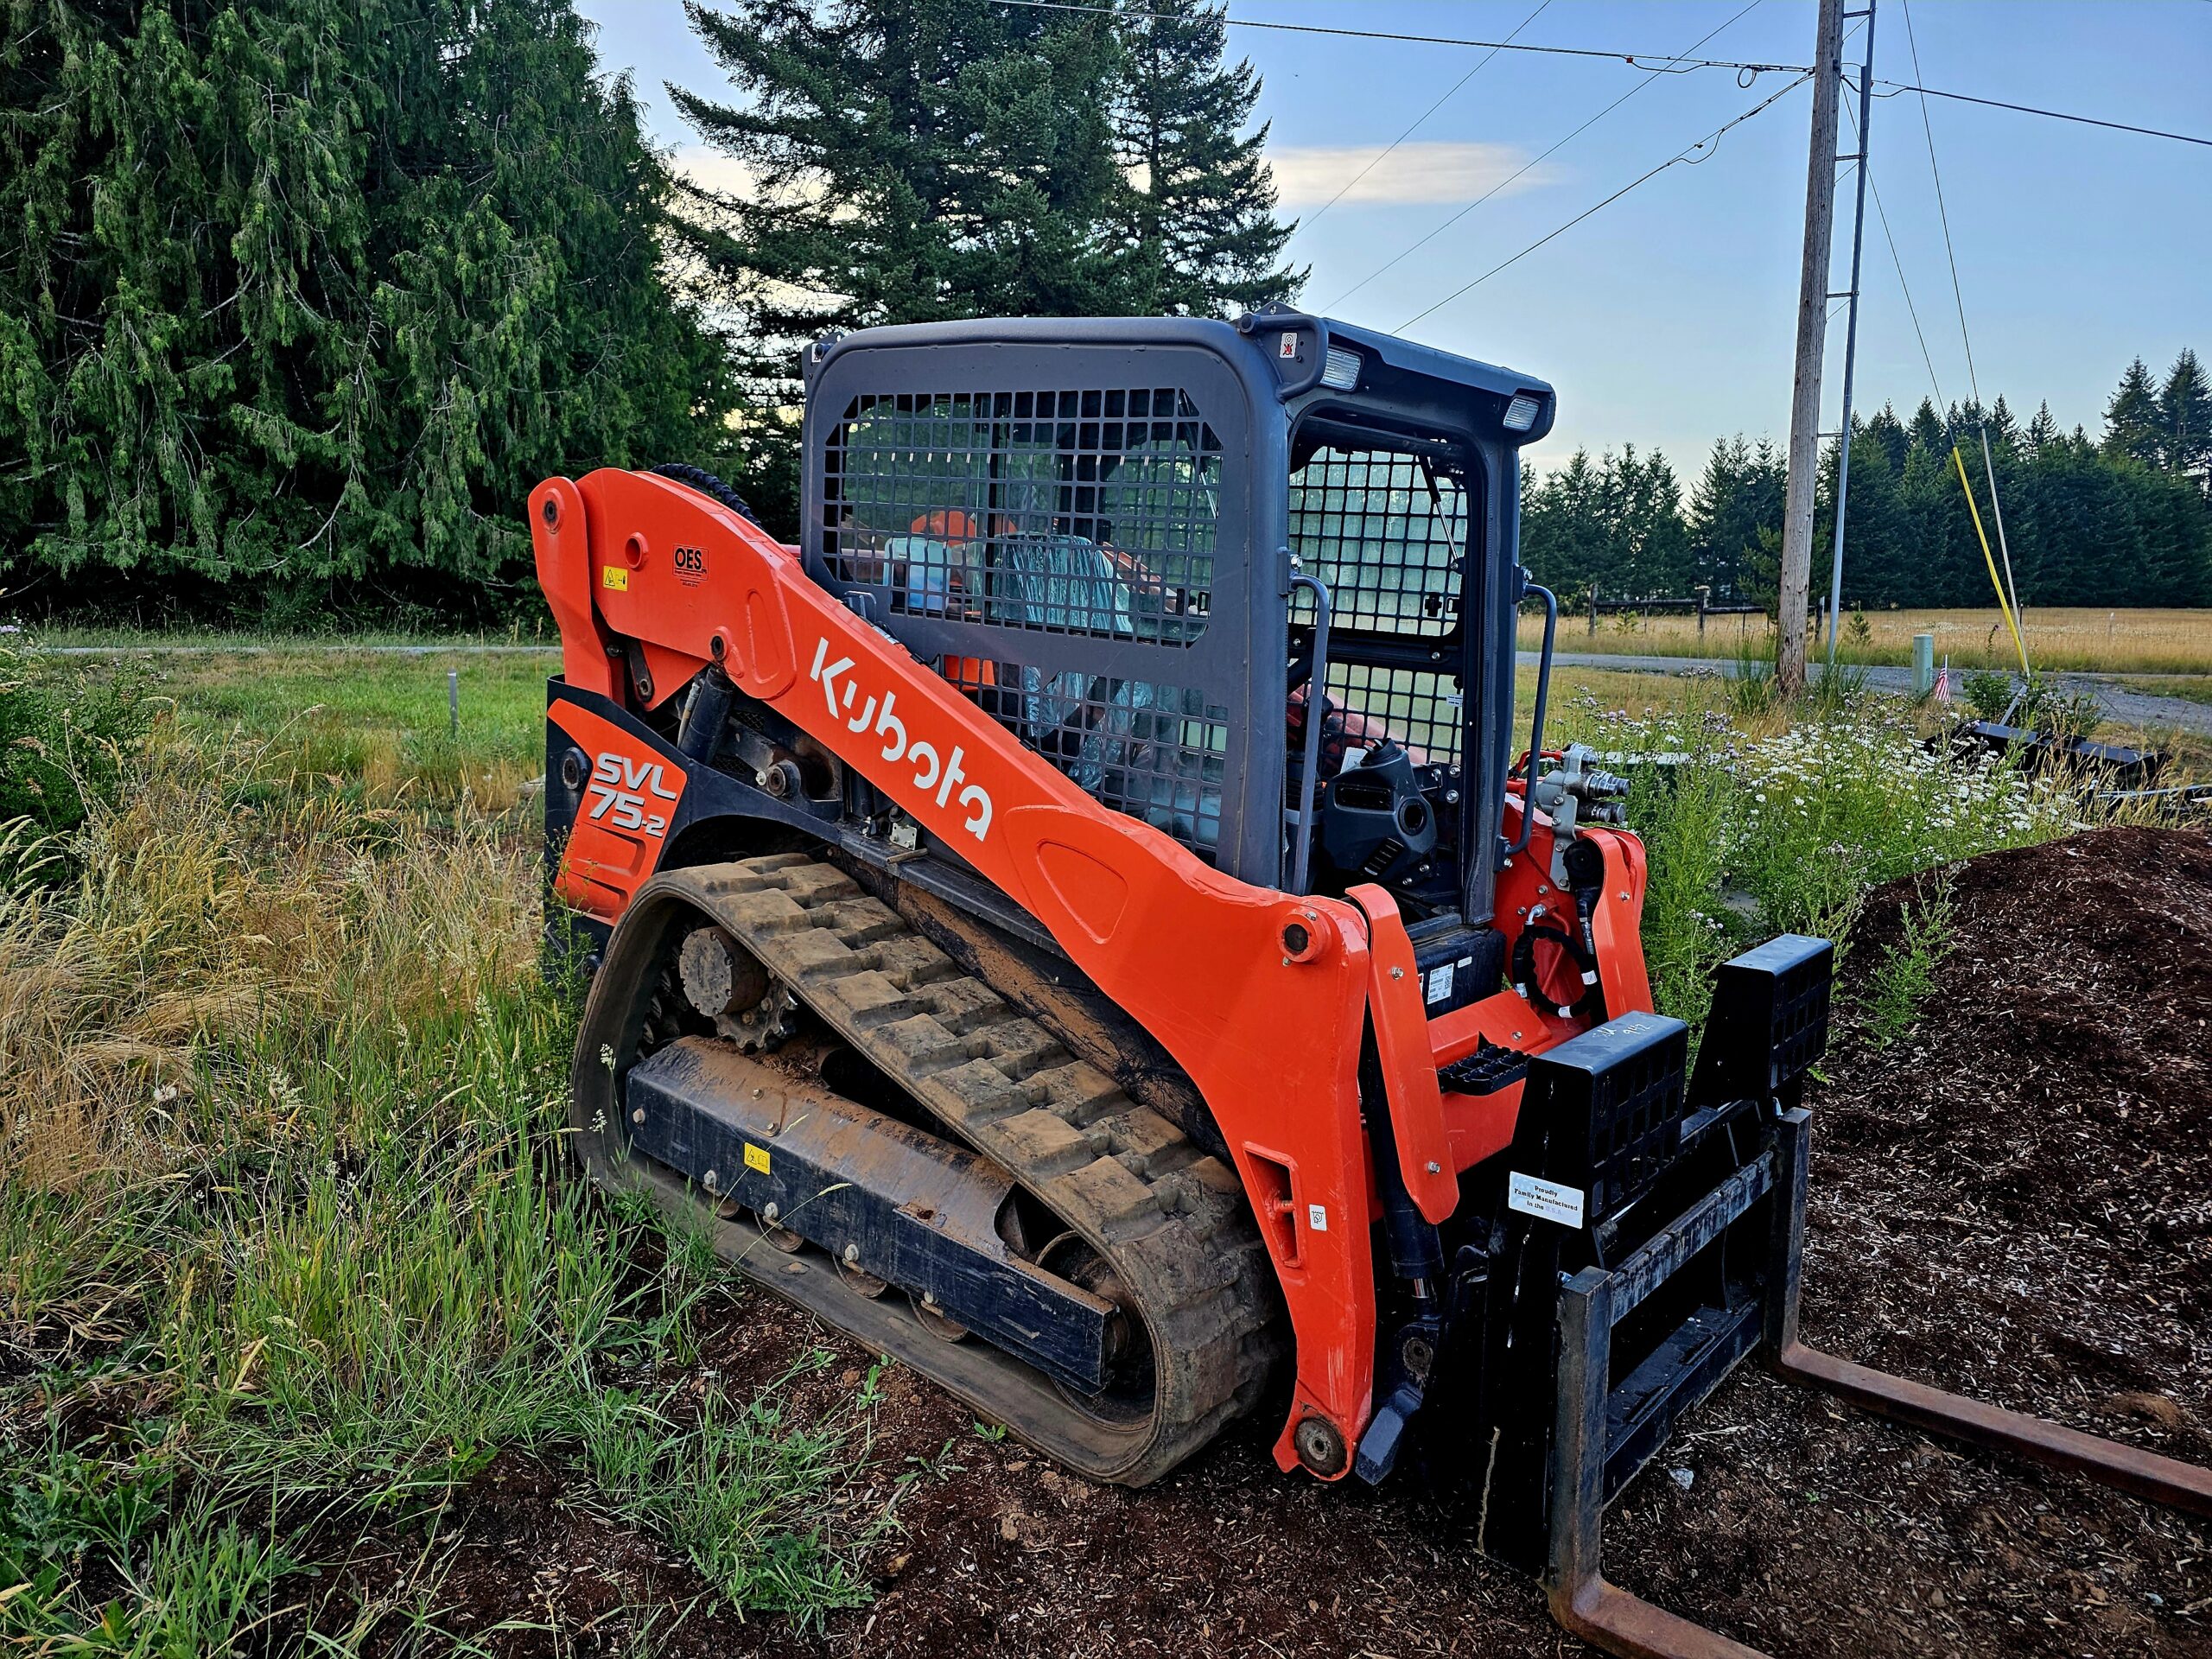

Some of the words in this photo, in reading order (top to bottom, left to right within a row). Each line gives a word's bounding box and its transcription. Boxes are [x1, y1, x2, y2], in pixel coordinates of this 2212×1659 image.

[675, 547, 702, 570] OES
[810, 636, 993, 842] Kubota
[594, 752, 677, 802] SVL
[589, 784, 666, 838] 75-2
[1514, 1188, 1535, 1199] Family
[1535, 1193, 1578, 1211] Manufactured
[1535, 1185, 1558, 1198] Proudly
